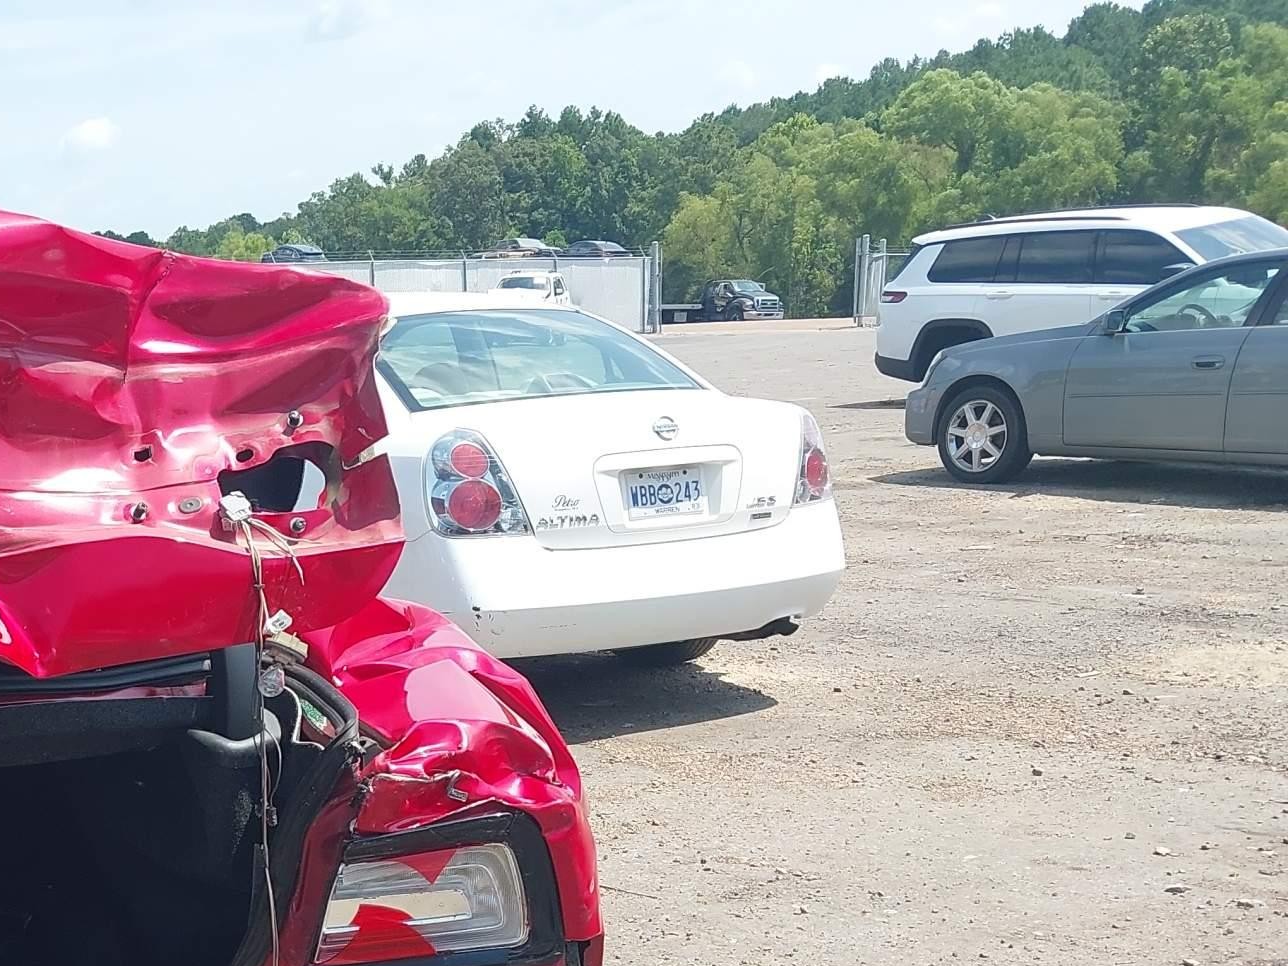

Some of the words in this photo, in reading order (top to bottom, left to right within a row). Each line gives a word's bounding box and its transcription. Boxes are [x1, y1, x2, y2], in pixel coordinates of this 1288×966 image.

[630, 484, 657, 507] WBB
[674, 480, 700, 503] 243
[536, 514, 599, 529] ALTIMA
